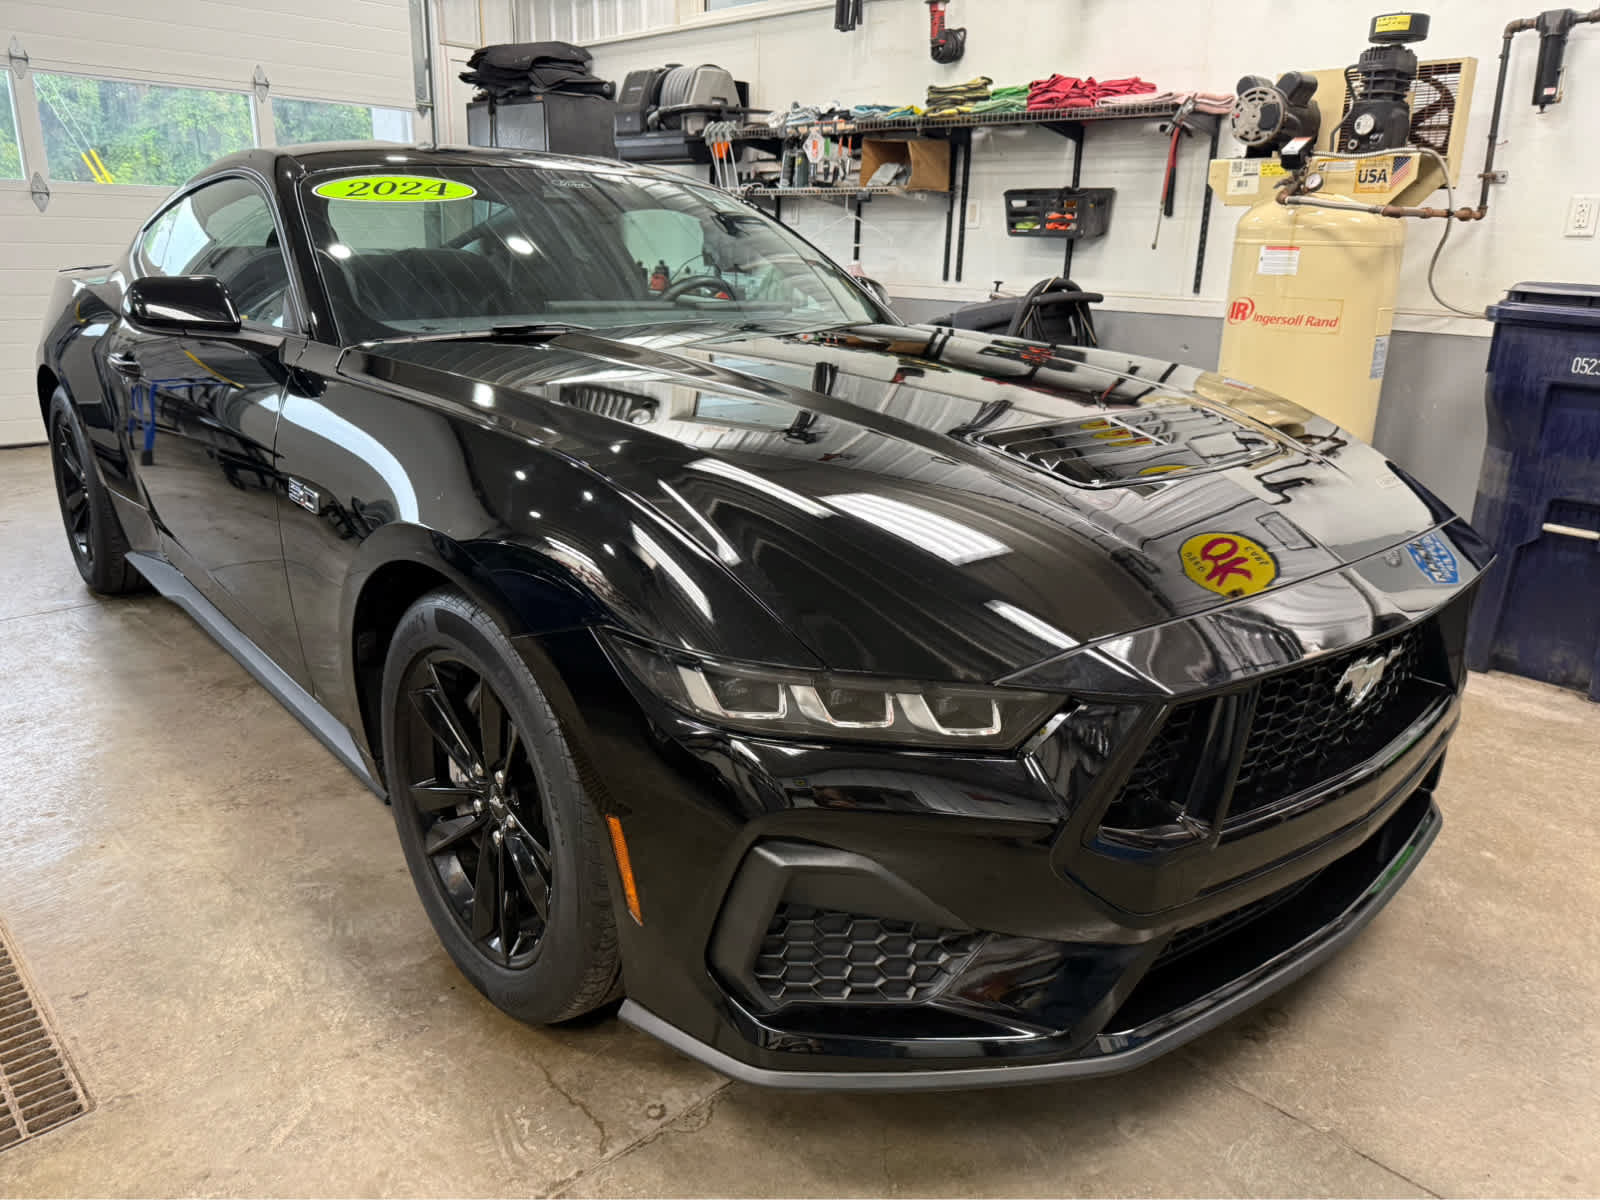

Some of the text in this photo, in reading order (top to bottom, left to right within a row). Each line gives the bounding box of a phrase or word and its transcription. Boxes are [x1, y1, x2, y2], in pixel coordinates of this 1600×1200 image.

[1358, 168, 1388, 184] USA
[345, 181, 449, 197] 2024
[1253, 312, 1339, 328] Ingersoll Rand
